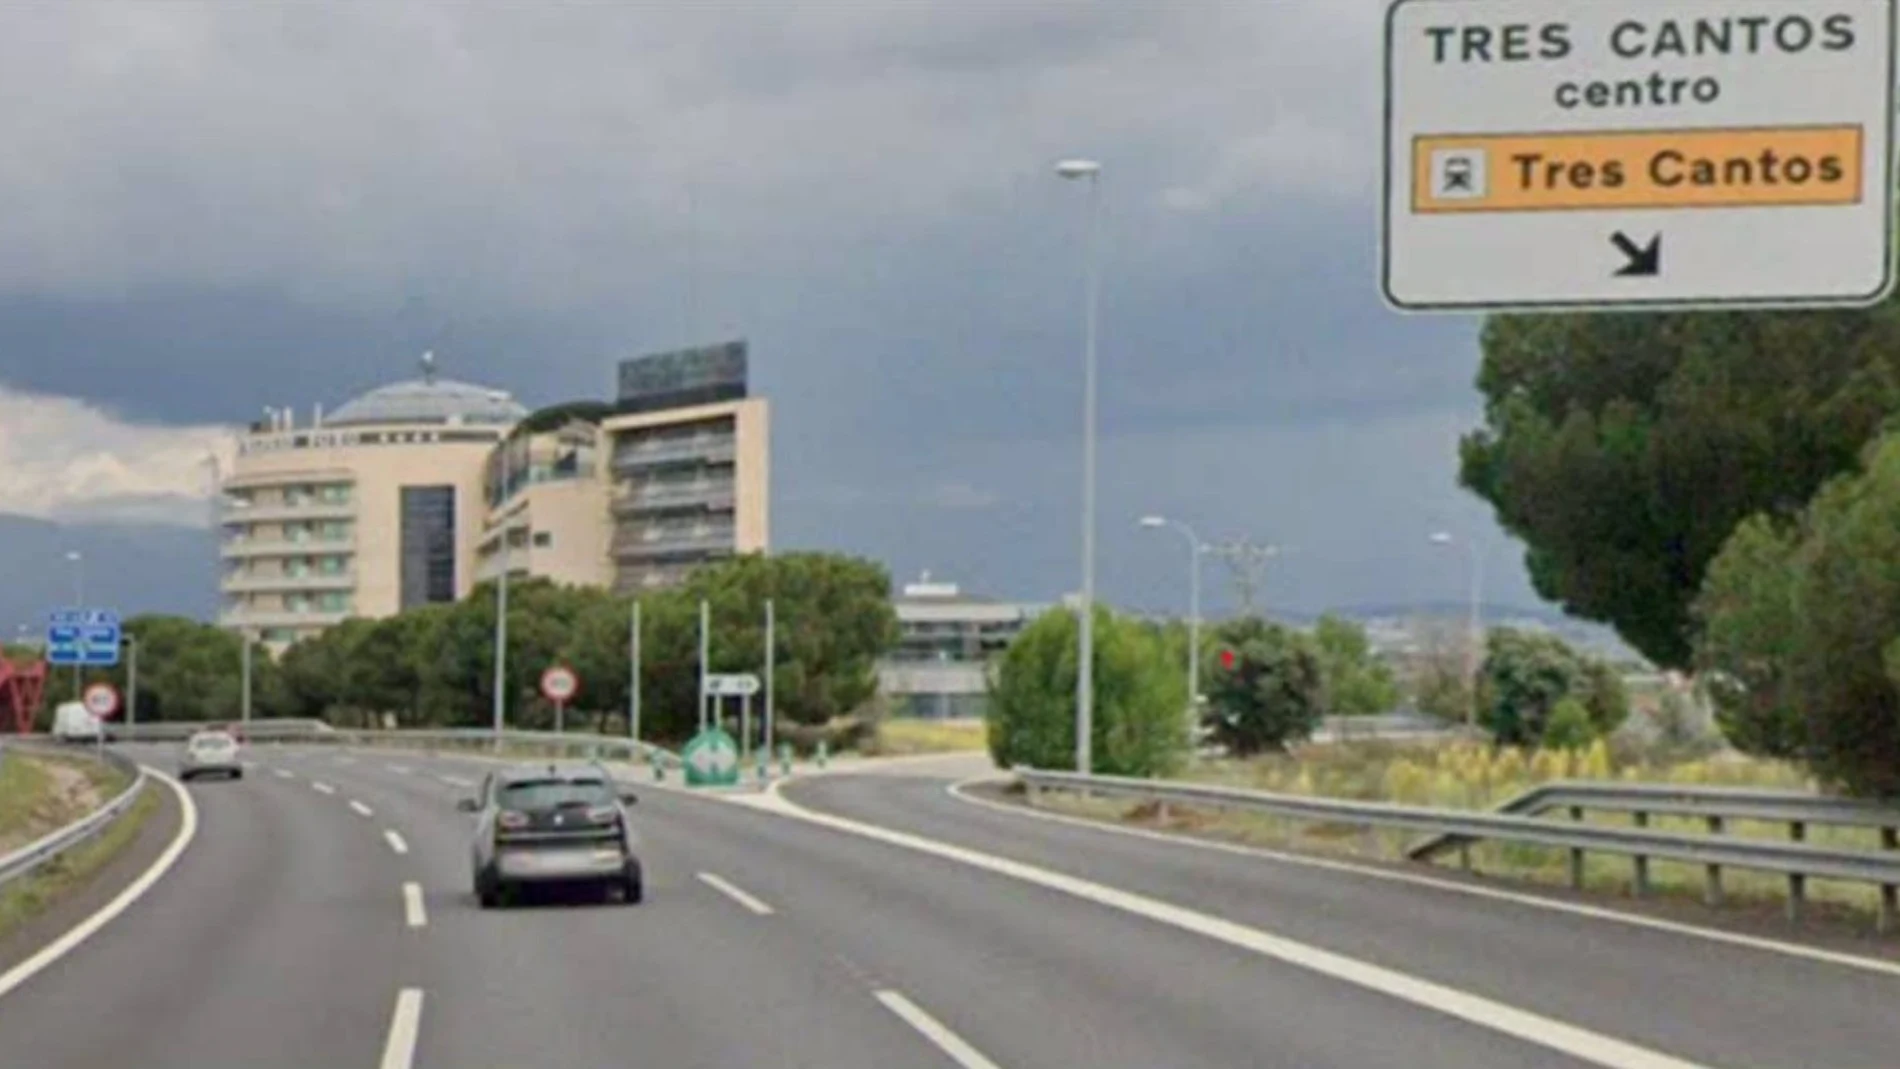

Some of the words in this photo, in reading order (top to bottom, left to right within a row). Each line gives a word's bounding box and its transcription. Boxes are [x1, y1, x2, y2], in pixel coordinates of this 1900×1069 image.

[1425, 24, 1572, 63] TRES
[1609, 14, 1856, 59] CANTOS
[1554, 72, 1721, 109] centro
[1511, 152, 1625, 190] Tres
[1648, 149, 1844, 188] Cantos
